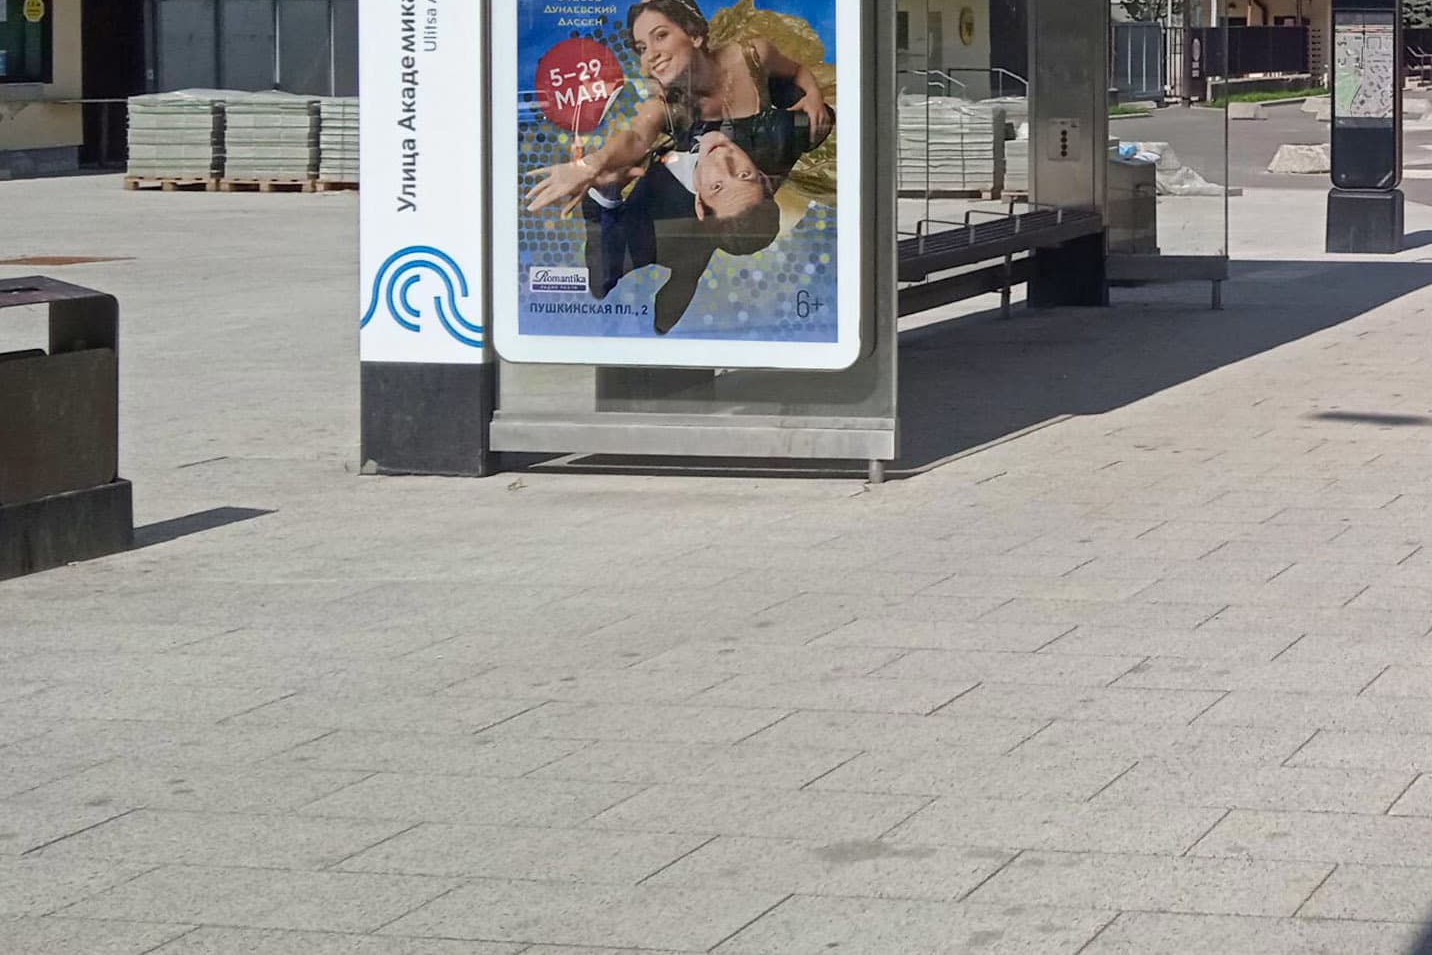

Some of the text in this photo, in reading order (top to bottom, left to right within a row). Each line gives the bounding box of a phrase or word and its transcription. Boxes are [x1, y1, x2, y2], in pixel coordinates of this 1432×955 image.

[423, 7, 438, 53] Ulitsa
[557, 17, 604, 27] ДАССЕН
[554, 80, 609, 110] МАЯ
[396, 138, 420, 213] Улица
[532, 269, 587, 283] Romantika
[529, 302, 612, 315] ПУШКИНСКАЯ
[641, 304, 649, 316] 2
[796, 289, 825, 319] 6+
